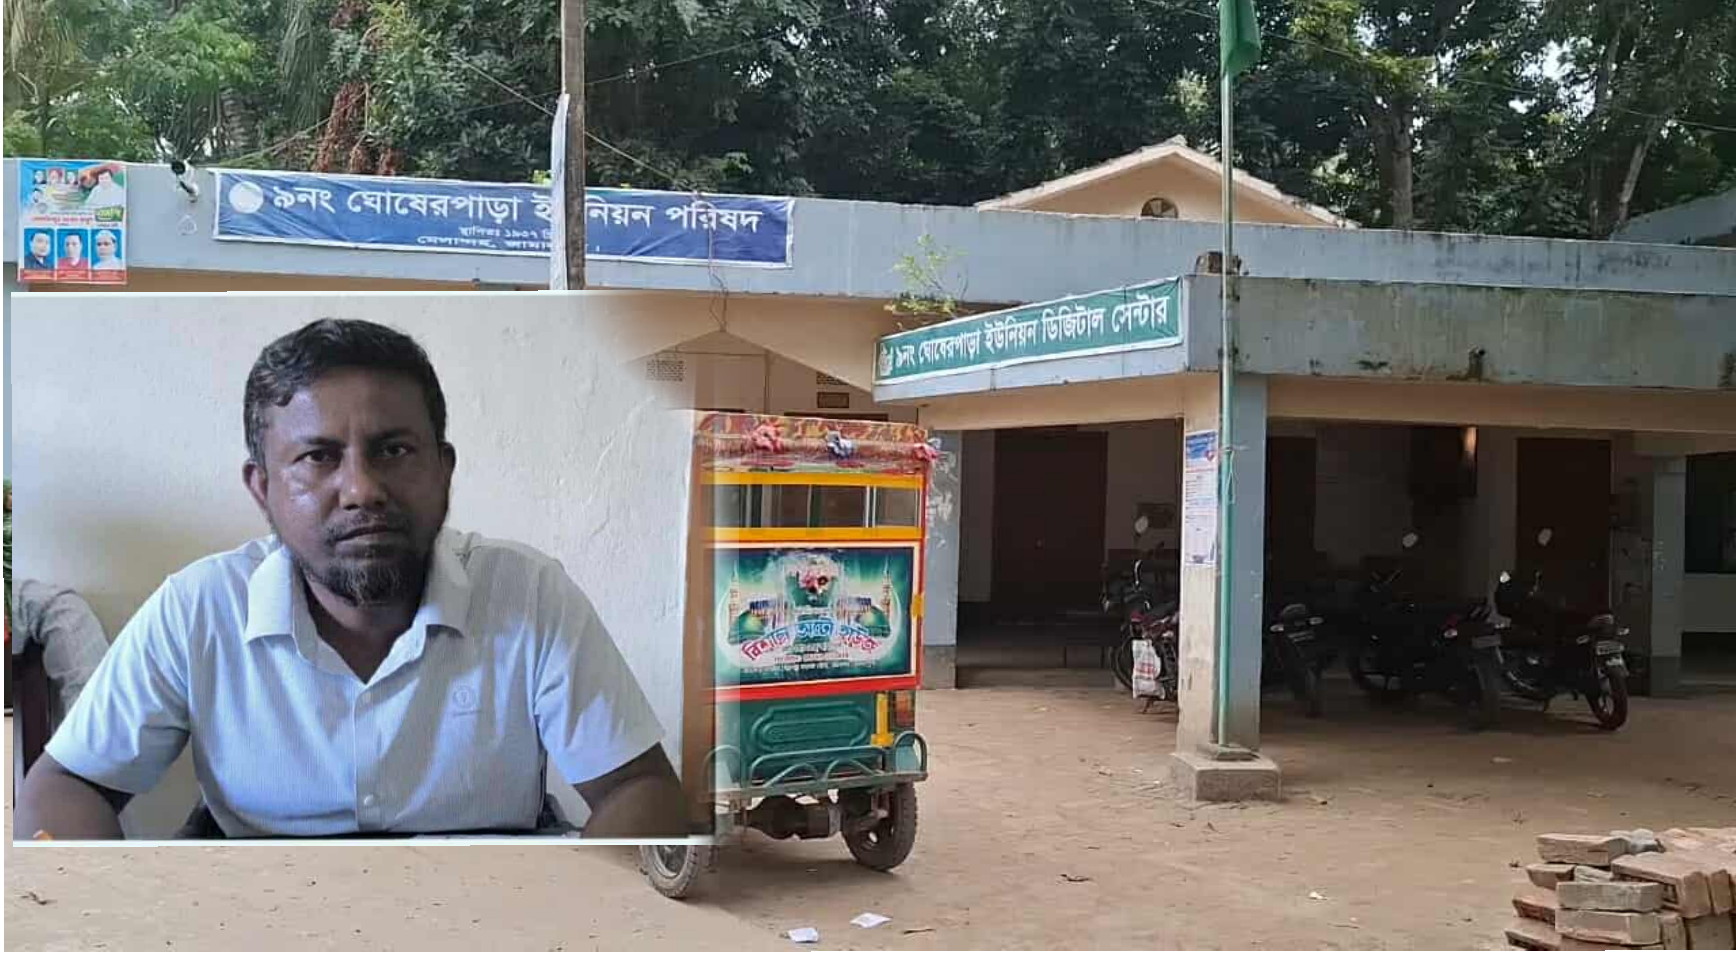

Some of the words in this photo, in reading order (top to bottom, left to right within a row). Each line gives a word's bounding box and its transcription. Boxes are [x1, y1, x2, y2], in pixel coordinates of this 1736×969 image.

[272, 185, 336, 213] ৯নং
[347, 189, 520, 226] ঘোষেরপাড়া
[530, 191, 656, 229] ইনিয়ন
[665, 199, 764, 234] পরিষদ
[895, 345, 915, 368] ৯নং
[918, 328, 982, 365] ঘোষেরপাড়া
[984, 315, 1037, 355] ইউনিয়ন
[1042, 304, 1105, 343] ডিজিটাল
[1111, 293, 1171, 334] সেন্টার
